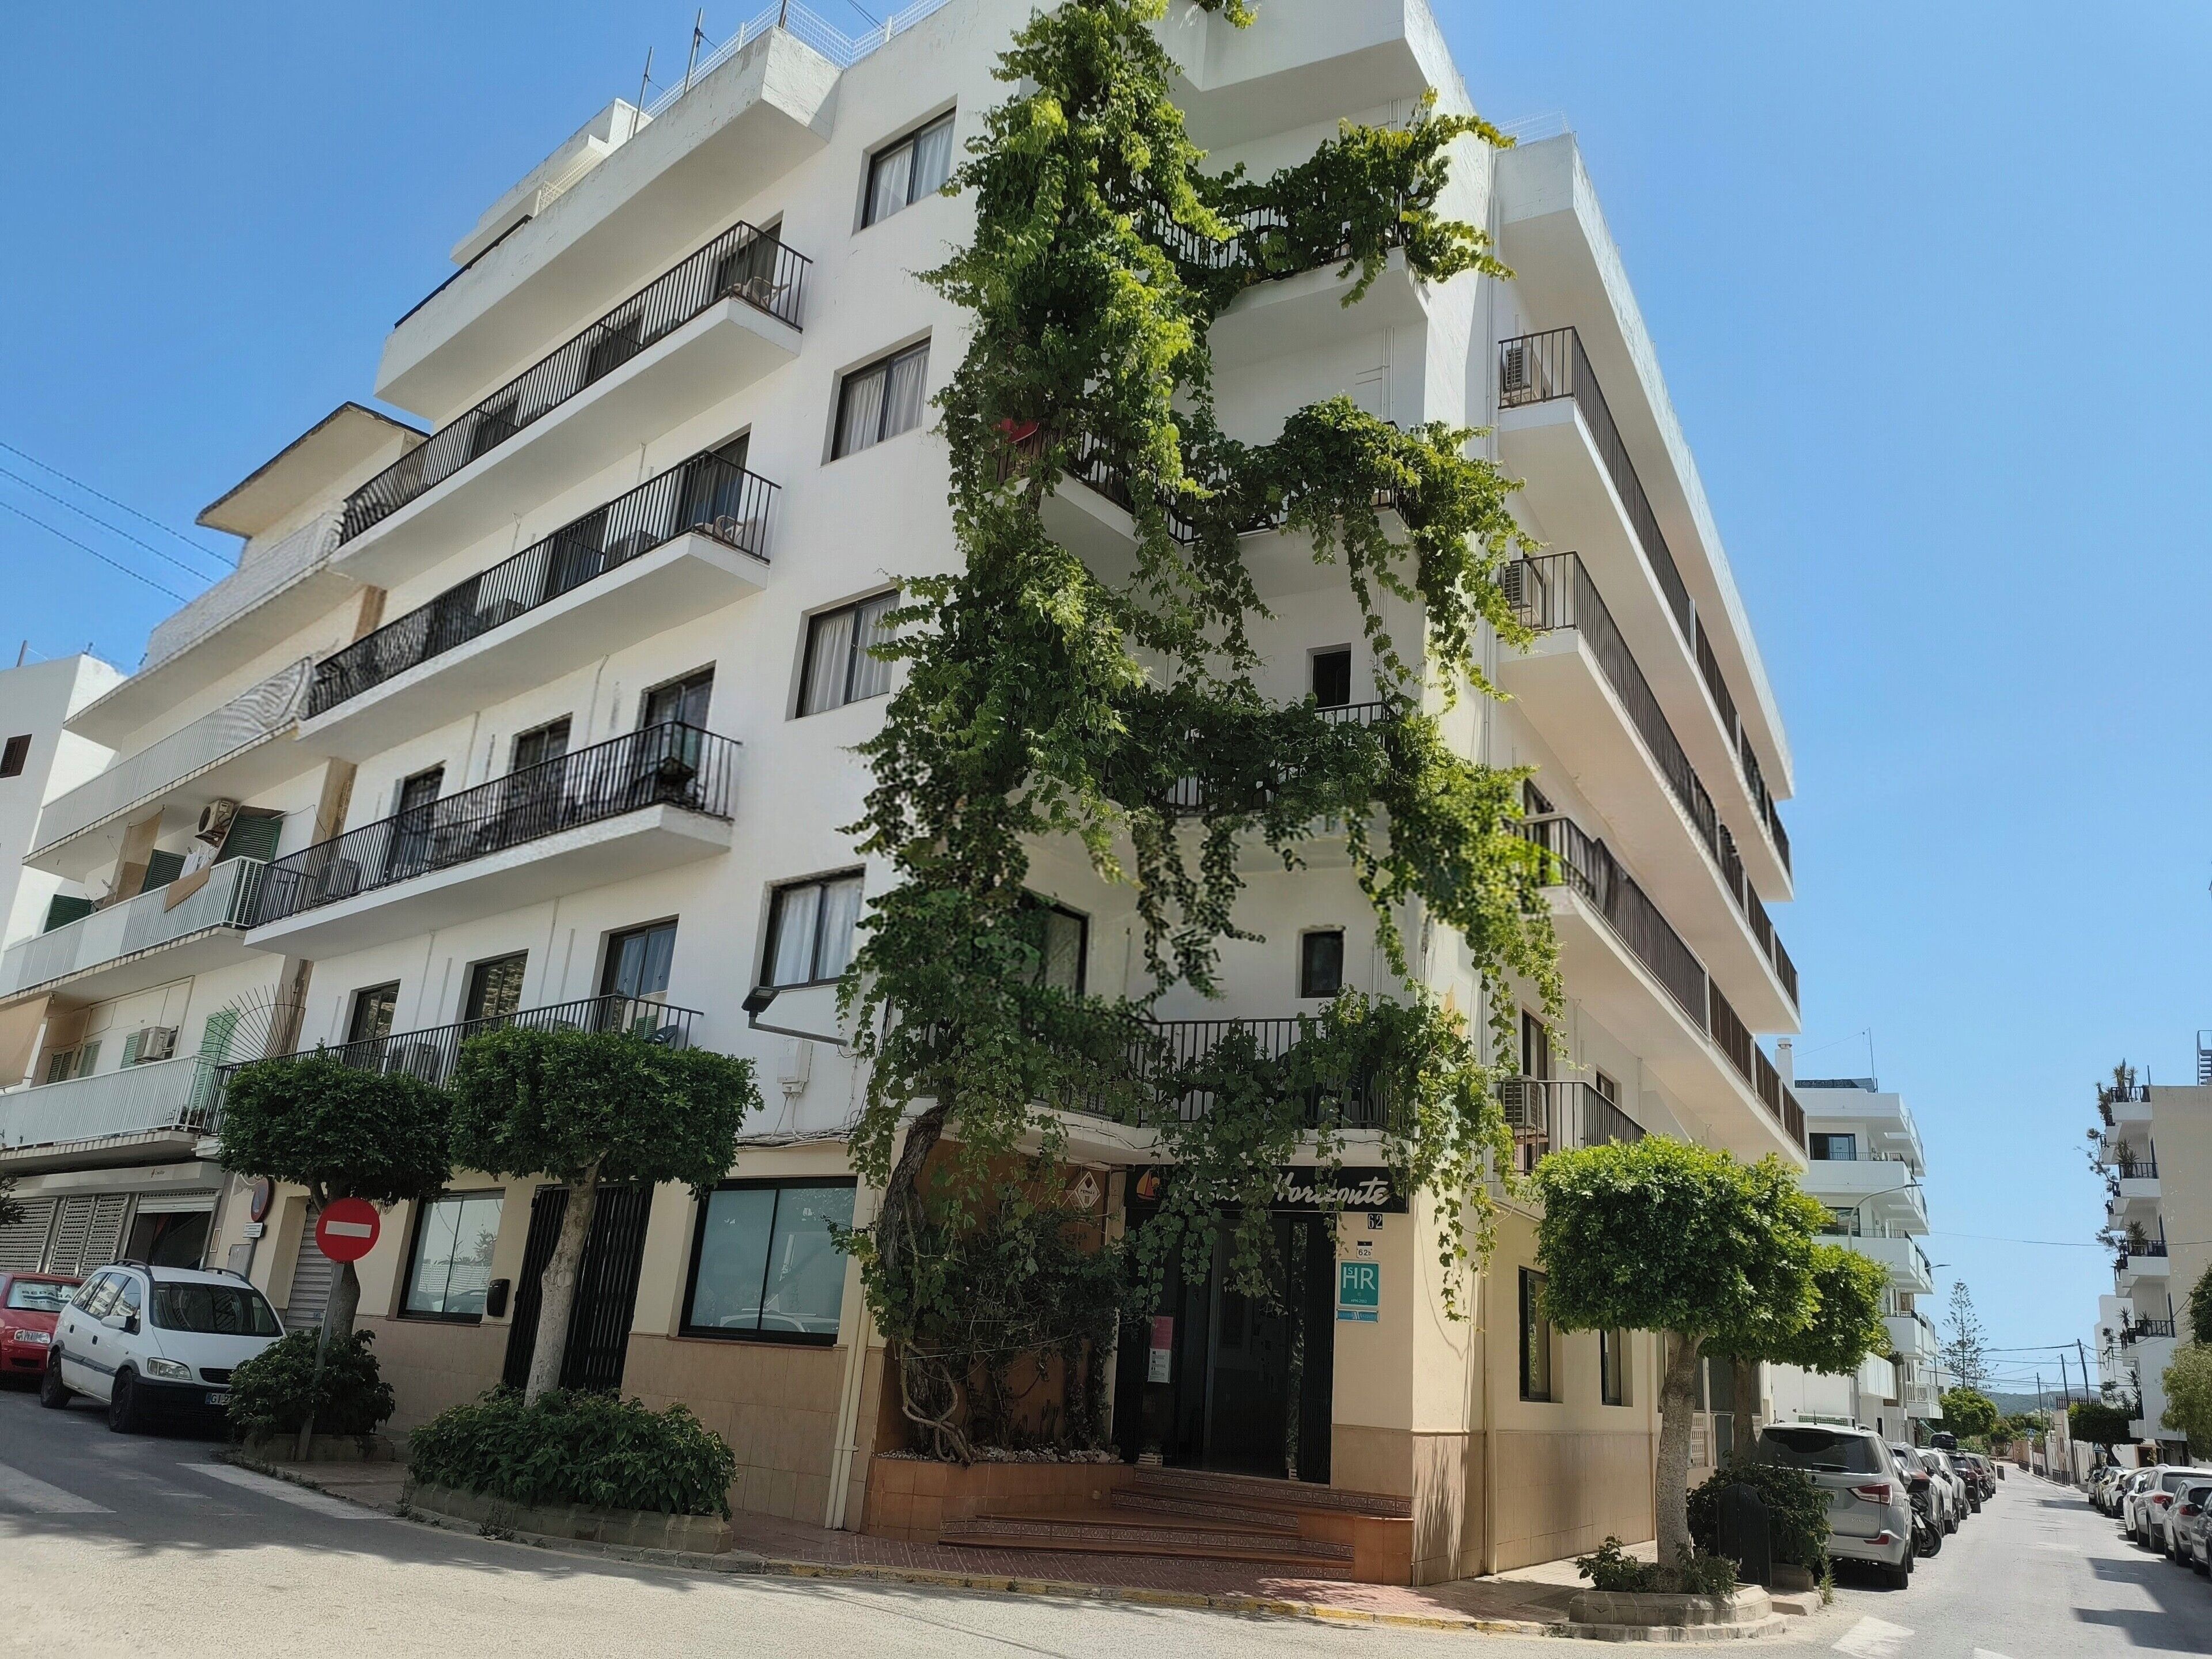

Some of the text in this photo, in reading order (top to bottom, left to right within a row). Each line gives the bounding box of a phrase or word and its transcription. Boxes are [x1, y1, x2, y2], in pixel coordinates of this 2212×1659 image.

[1368, 1214, 1382, 1229] 62
[1343, 1267, 1376, 1290] HR
[1348, 1267, 1353, 1275] S
